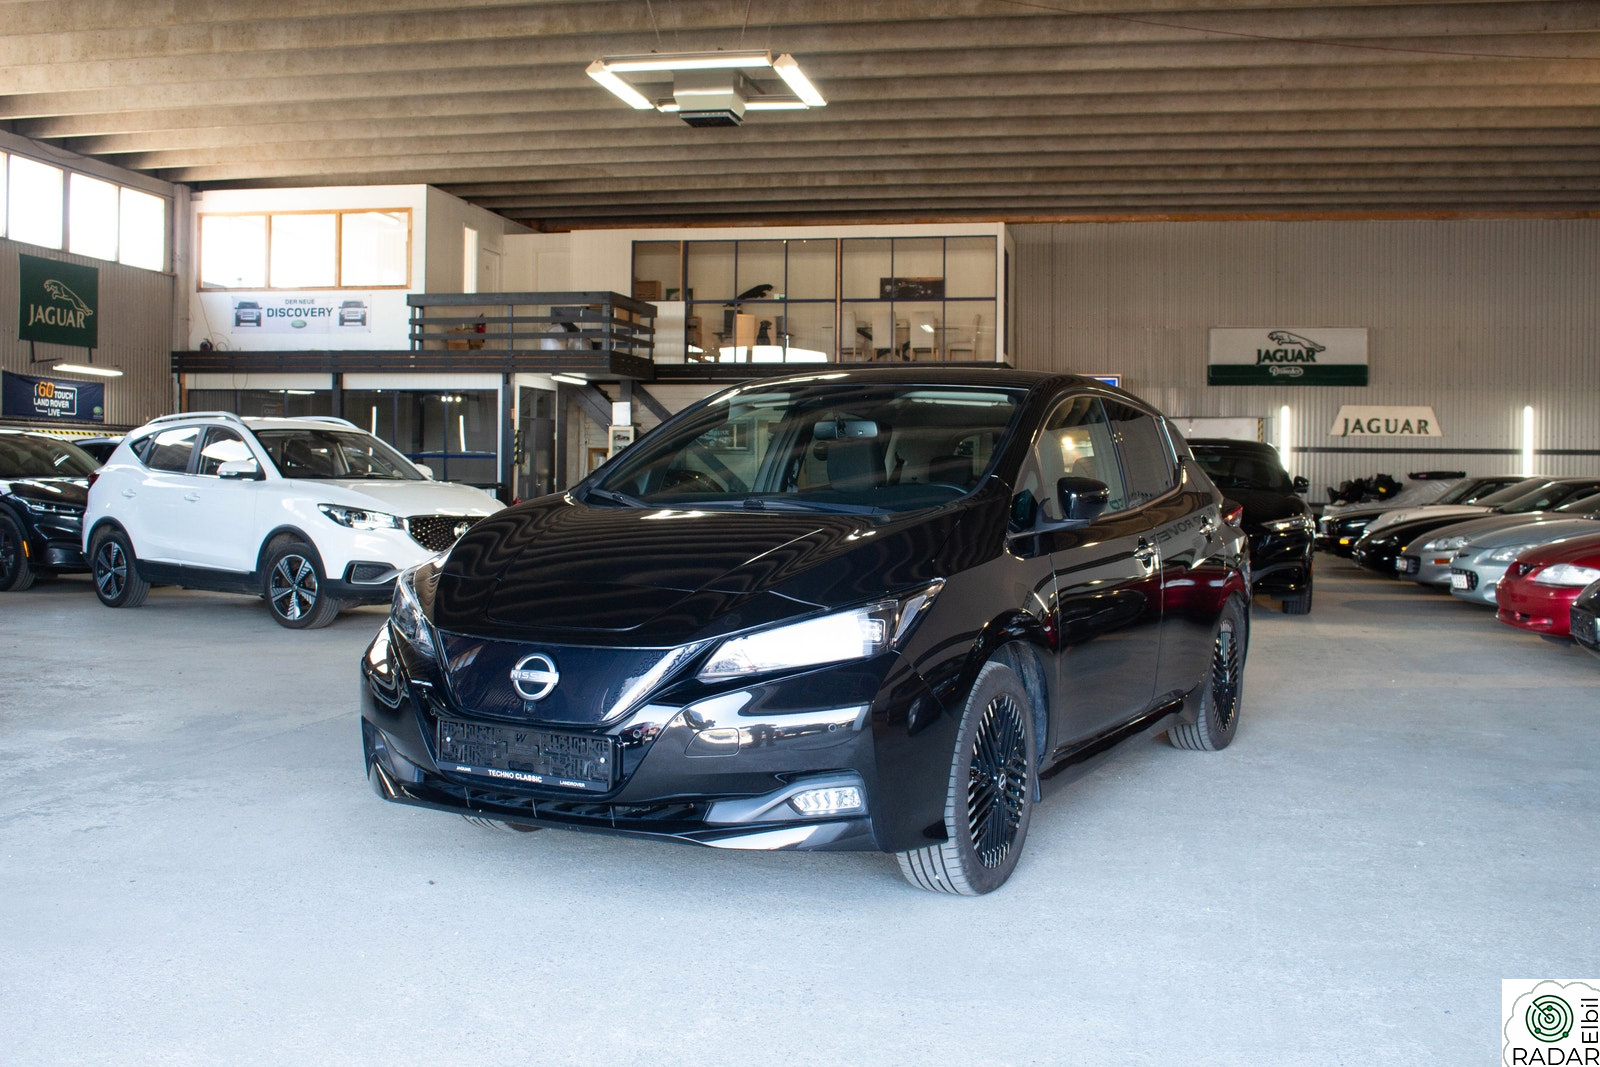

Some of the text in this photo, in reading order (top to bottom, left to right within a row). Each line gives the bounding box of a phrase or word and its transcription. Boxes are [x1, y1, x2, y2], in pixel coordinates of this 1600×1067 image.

[28, 303, 86, 329] JAGUAR
[266, 307, 334, 318] DISCOVERY
[1256, 349, 1316, 365] JAGUAR
[38, 381, 74, 400] 60 TOUCH
[34, 397, 70, 409] LAND ROVER
[48, 408, 60, 416] LIVE
[1341, 417, 1429, 437] JAGUAR
[487, 769, 543, 784] TECHNO CLASSIC
